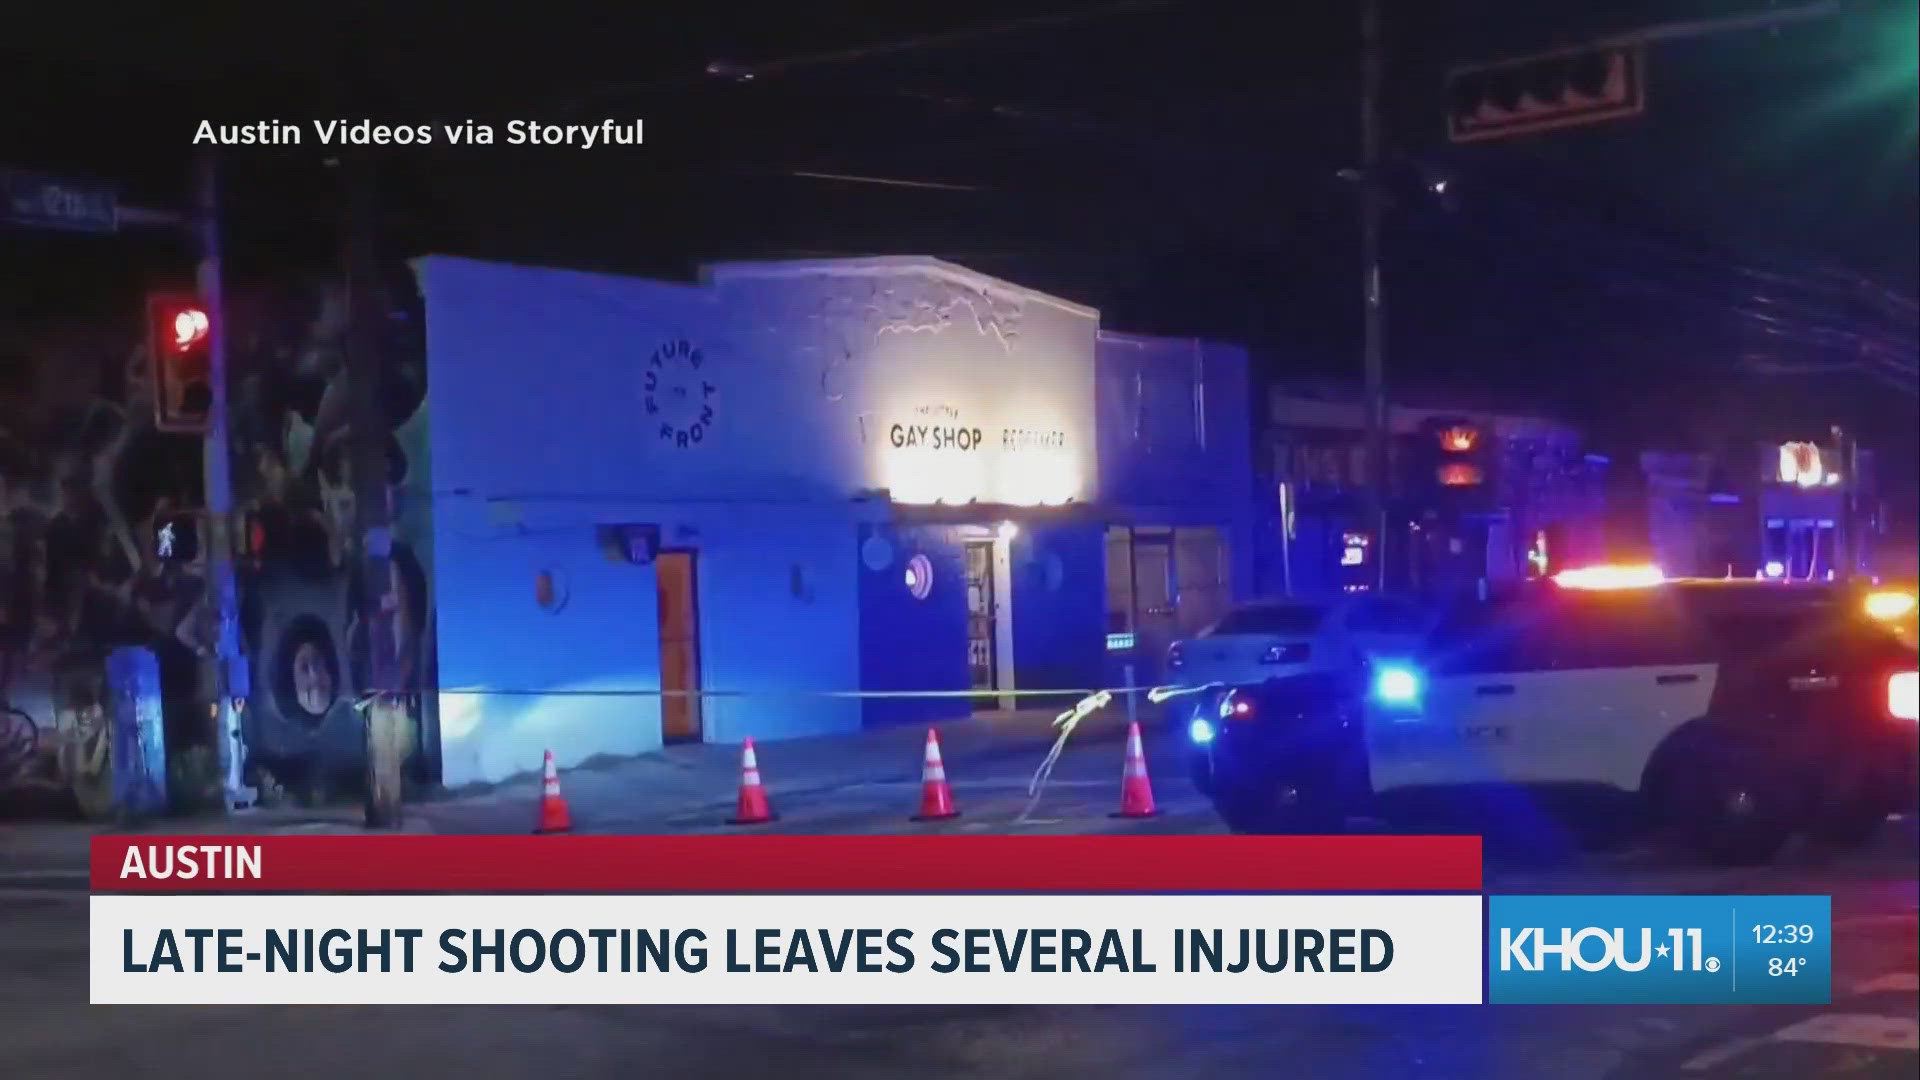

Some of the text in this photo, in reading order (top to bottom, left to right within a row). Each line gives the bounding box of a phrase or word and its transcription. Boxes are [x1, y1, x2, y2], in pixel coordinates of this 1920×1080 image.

[645, 340, 704, 415] FUTURE
[660, 381, 716, 449] FRONT
[890, 424, 982, 451] GAY SHOP
